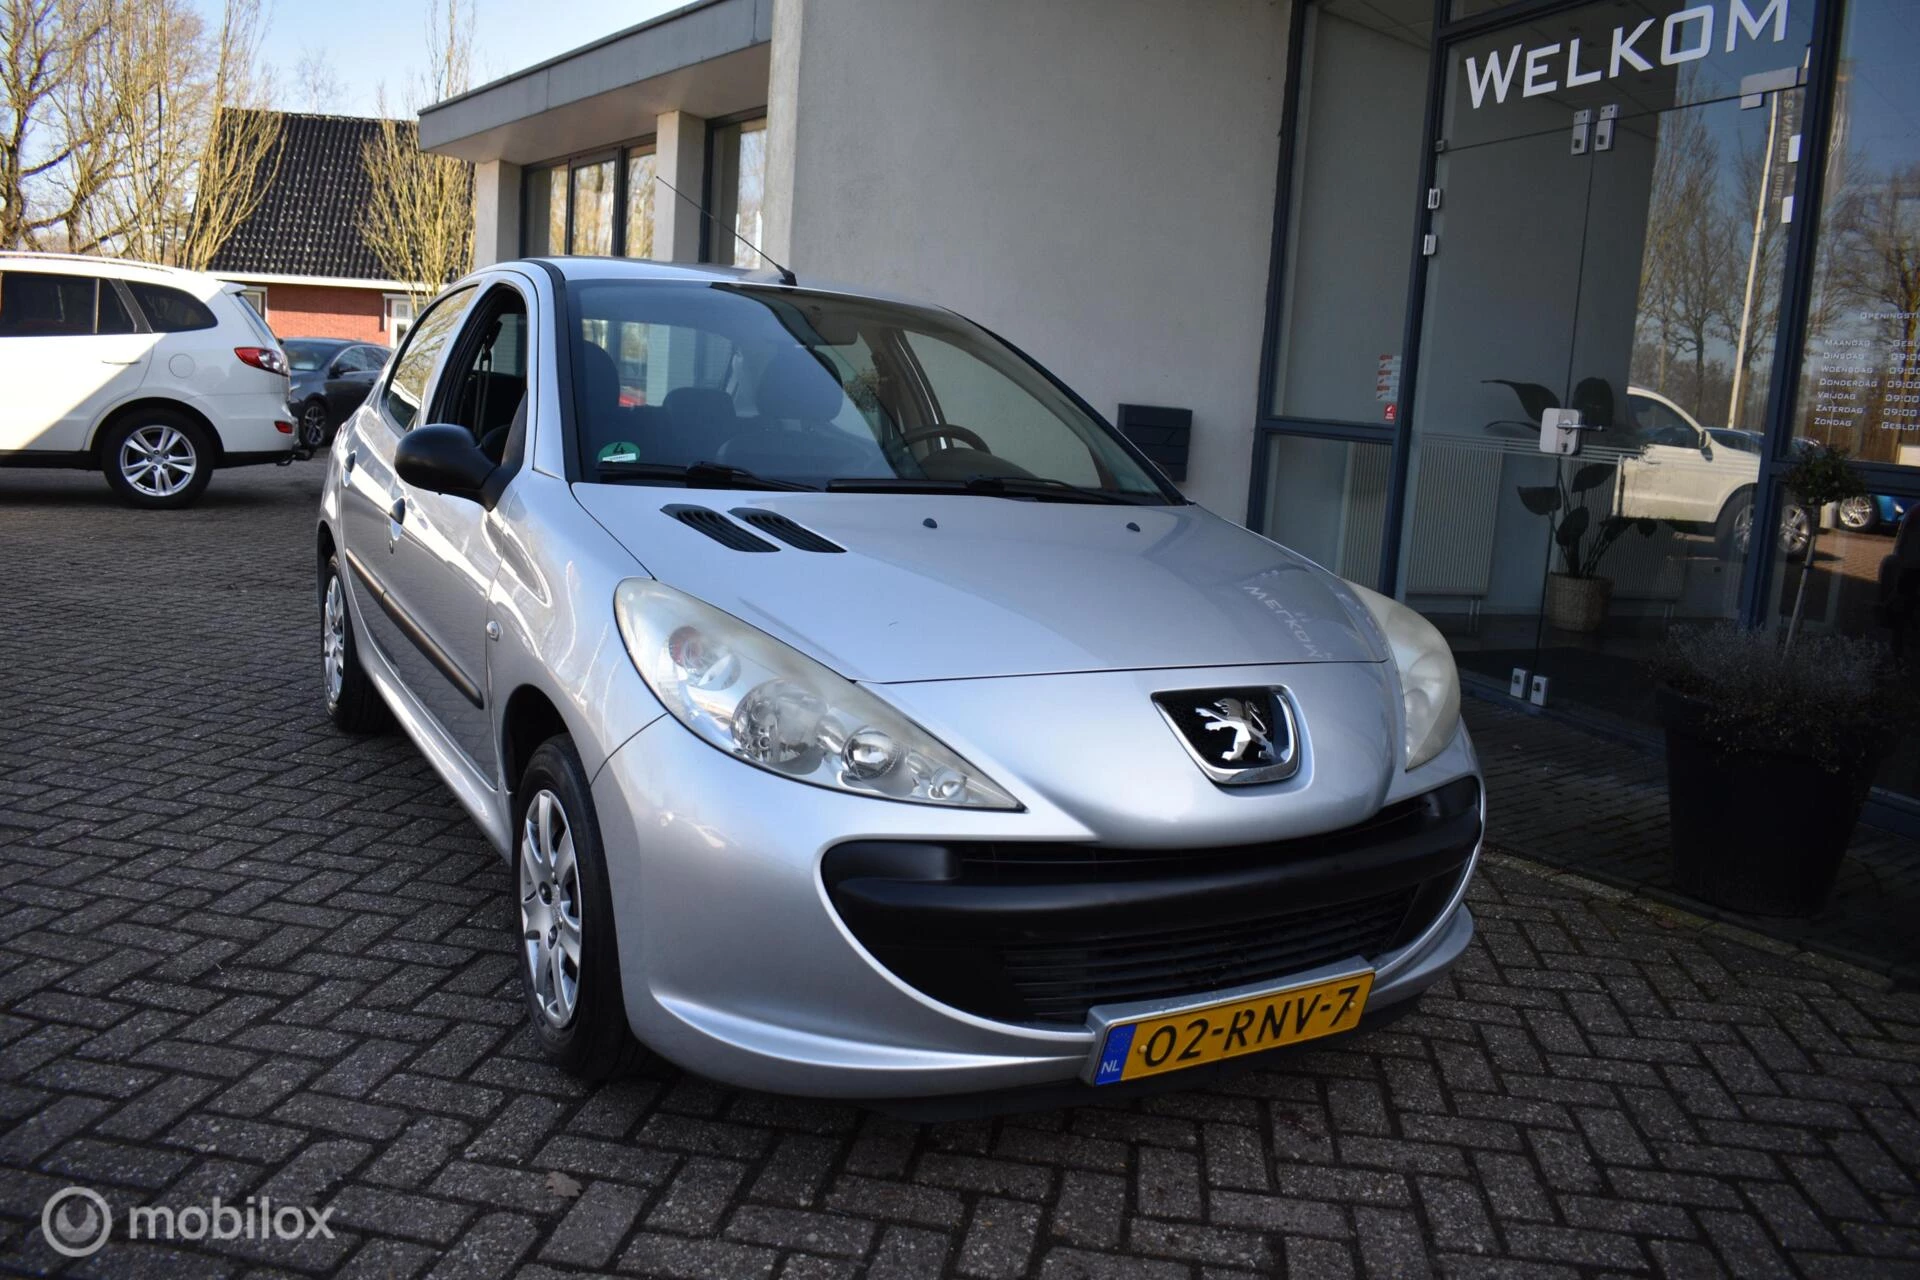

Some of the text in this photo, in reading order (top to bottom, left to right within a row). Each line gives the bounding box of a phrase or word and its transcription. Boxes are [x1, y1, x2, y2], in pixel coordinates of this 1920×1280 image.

[1465, 0, 1791, 110] WELKOM
[1101, 1059, 1120, 1074] NL
[1144, 984, 1360, 1067] 02-RNV-7
